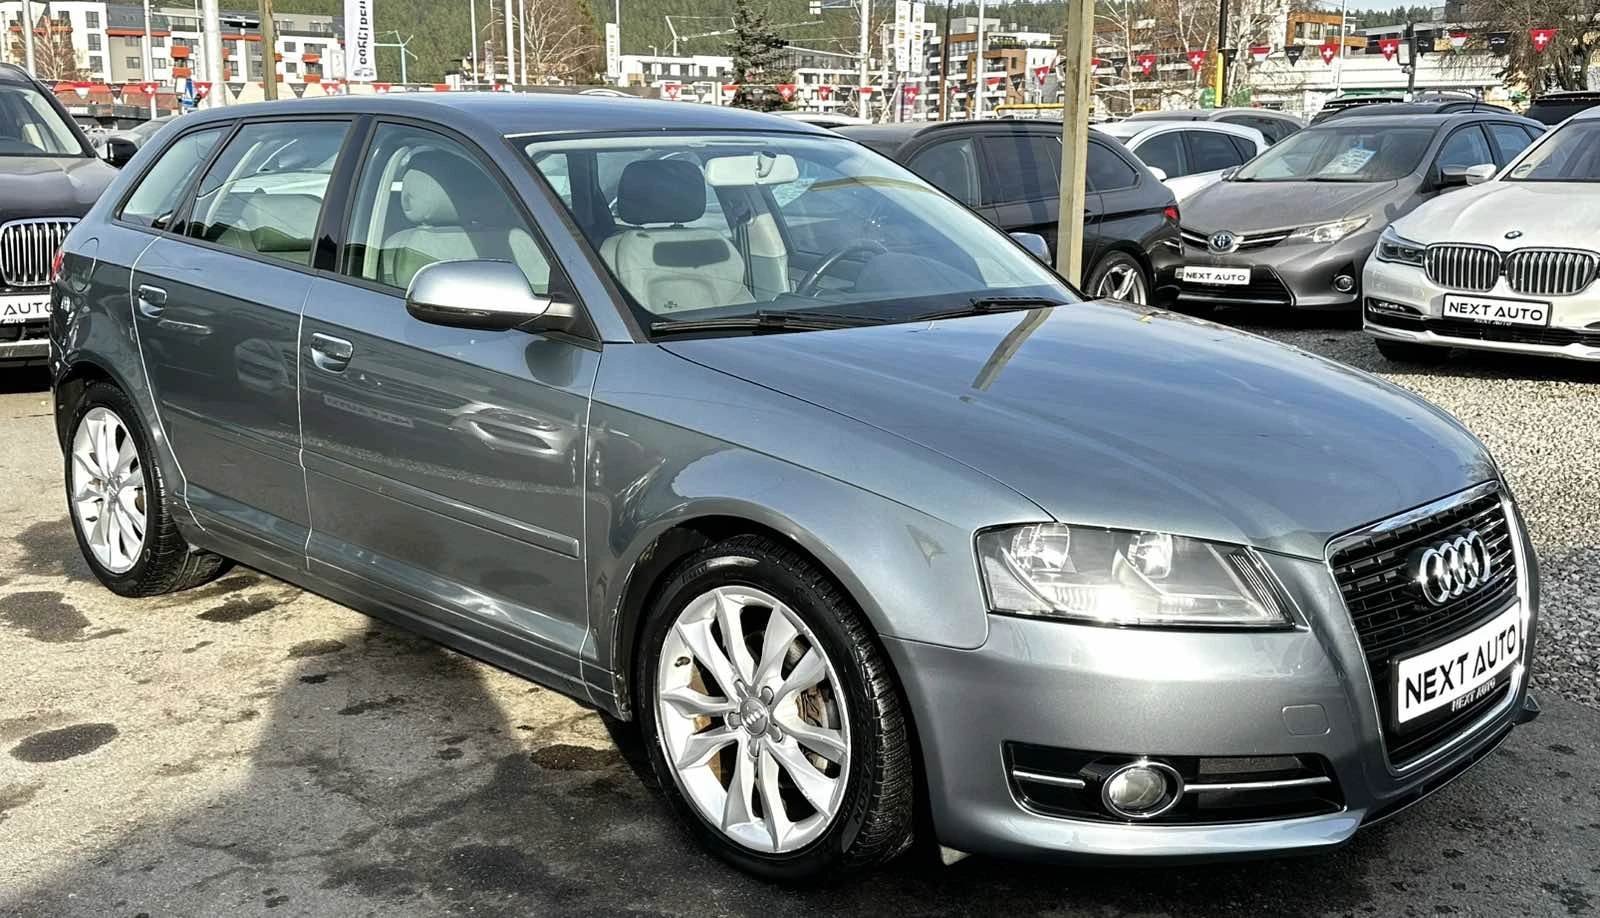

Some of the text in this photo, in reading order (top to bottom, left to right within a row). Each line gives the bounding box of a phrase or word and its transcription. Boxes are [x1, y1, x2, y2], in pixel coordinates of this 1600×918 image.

[1186, 272, 1212, 280] NEXT
[1449, 302, 1543, 321] NEXT AUTO
[1405, 624, 1516, 709] NEXT AUTO
[1451, 677, 1496, 713] NEXT AUTO
